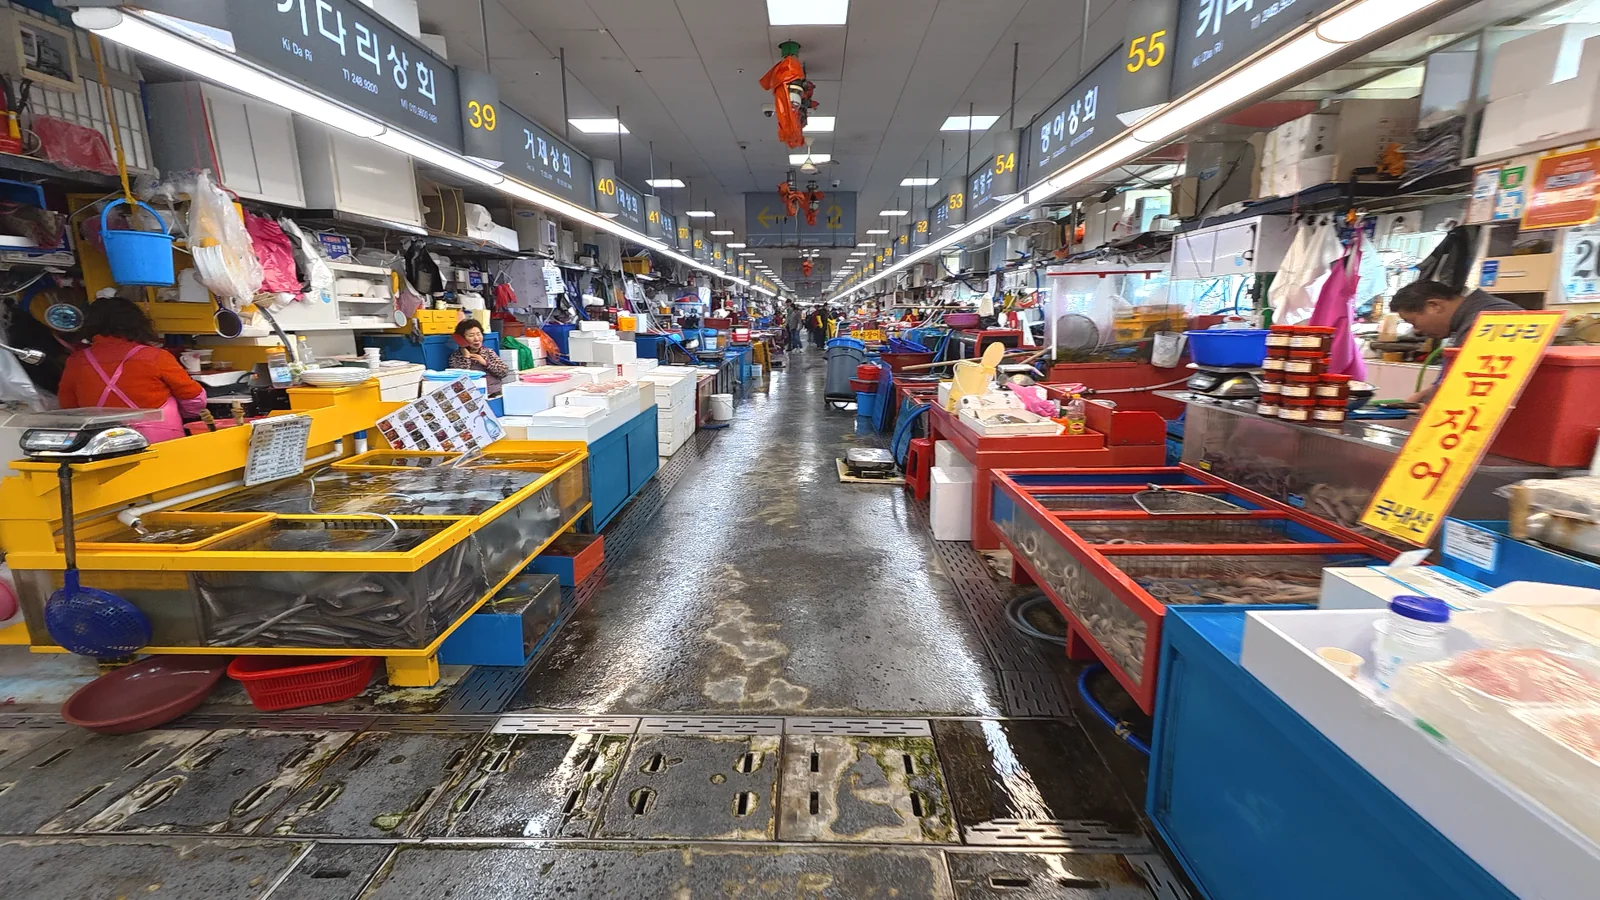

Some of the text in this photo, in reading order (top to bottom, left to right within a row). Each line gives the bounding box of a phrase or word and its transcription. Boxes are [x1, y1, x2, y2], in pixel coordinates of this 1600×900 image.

[281, 37, 313, 62] Ki Da Ri
[1126, 29, 1167, 74] 55
[468, 100, 496, 132] 39
[523, 128, 572, 179] 거제상회
[995, 152, 1015, 175] 54
[597, 178, 615, 196] 40
[615, 186, 638, 215] 상회
[949, 193, 963, 210] 53
[649, 210, 659, 224] 41
[826, 204, 842, 229] 2
[916, 220, 928, 233] 52
[693, 239, 703, 249] 42
[900, 235, 908, 245] 51
[1572, 240, 1600, 278] 2
[1476, 323, 1548, 343] 키다리
[1410, 354, 1517, 501] 꼼장어
[1375, 497, 1435, 534] 국내산
